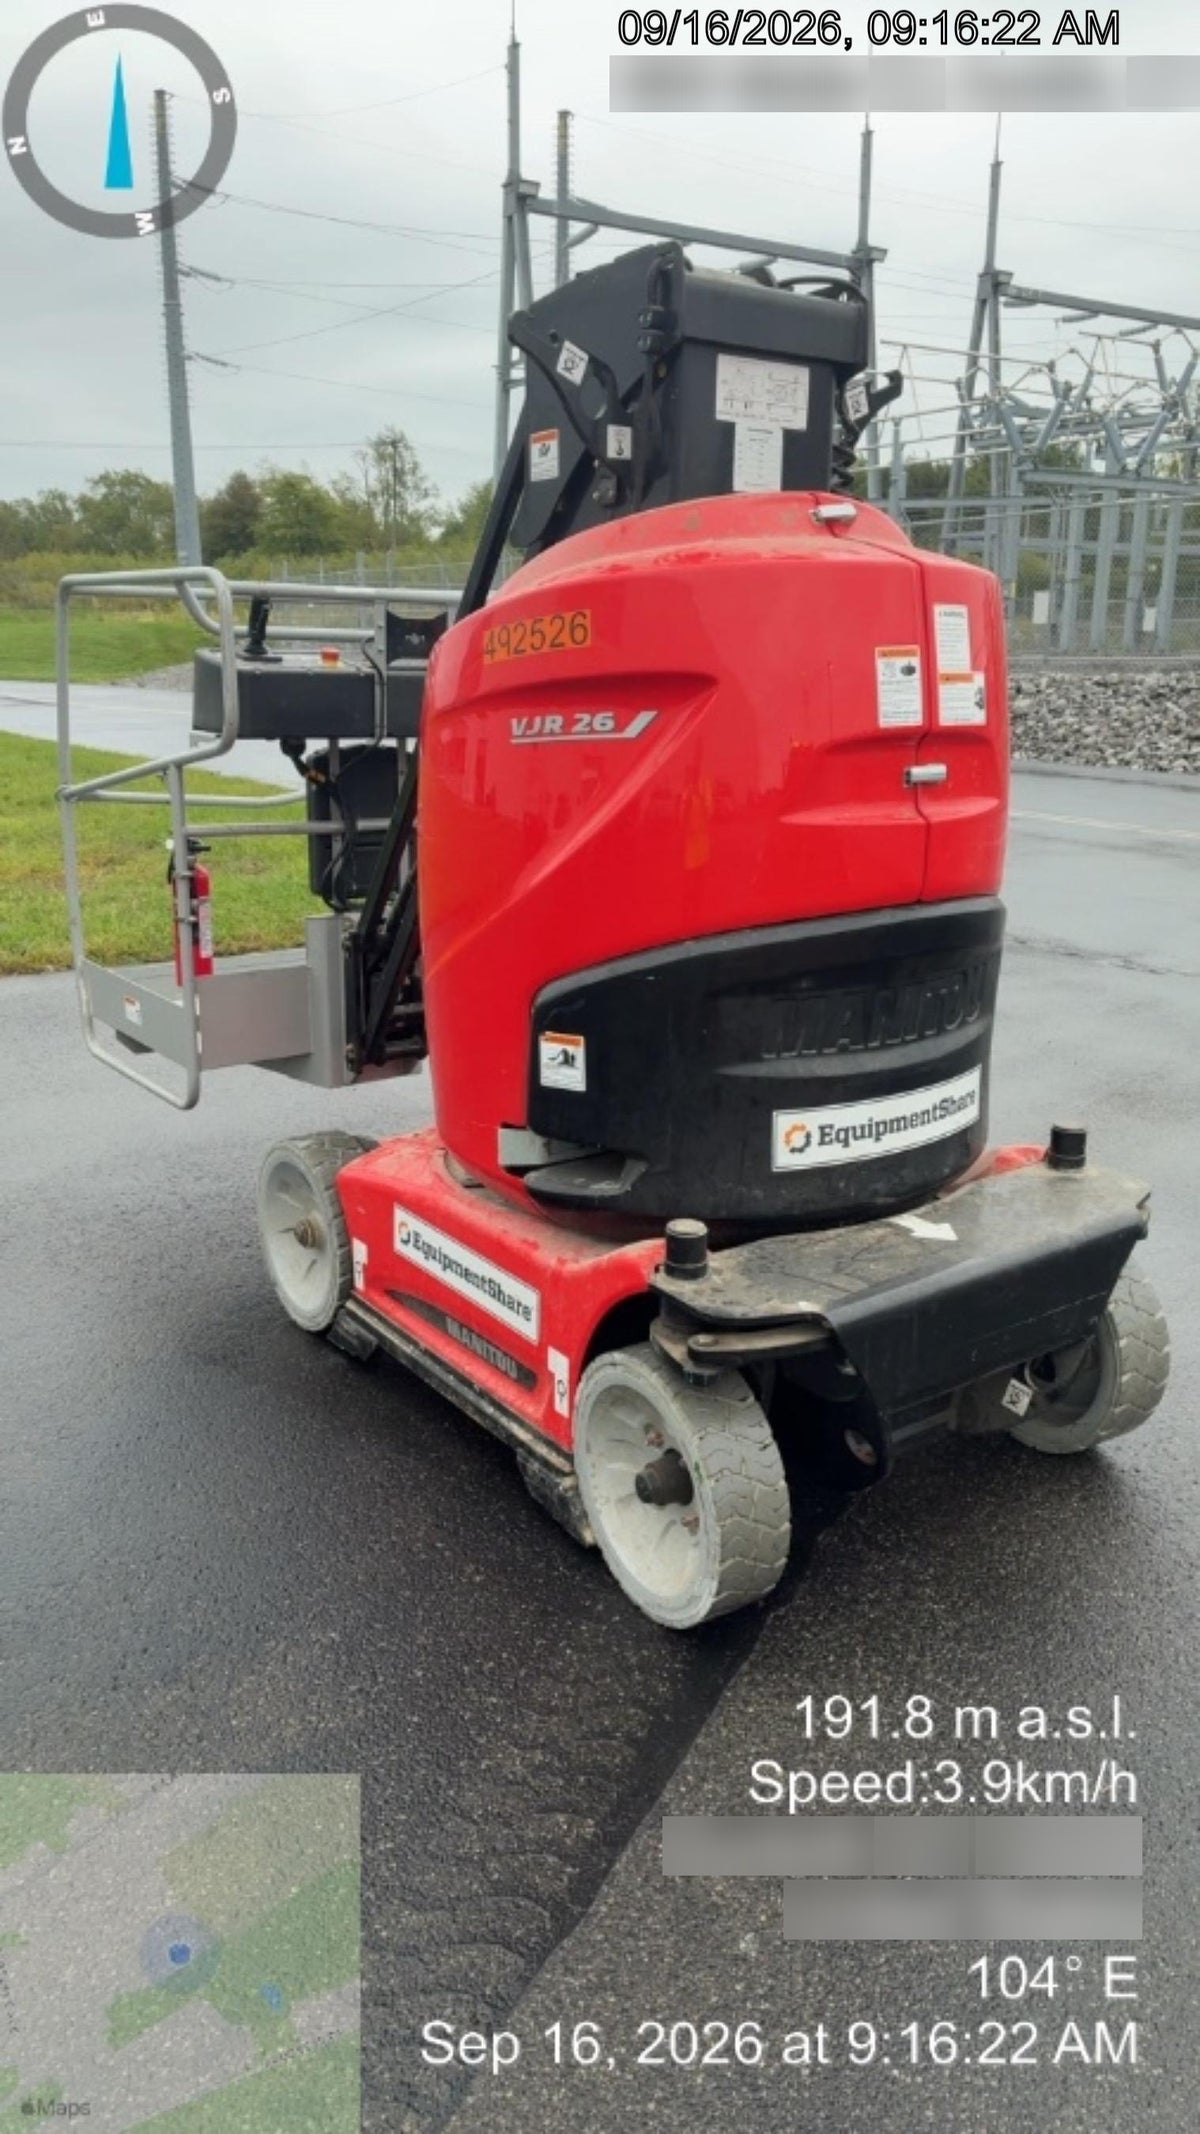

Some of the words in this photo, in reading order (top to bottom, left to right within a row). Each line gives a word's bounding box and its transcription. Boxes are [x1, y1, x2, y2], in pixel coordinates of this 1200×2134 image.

[485, 611, 589, 660] 492526
[511, 715, 564, 736] VJR
[571, 711, 616, 733] 26
[817, 1087, 976, 1148] EquipmentShare
[412, 1229, 532, 1323] EquipmentShare
